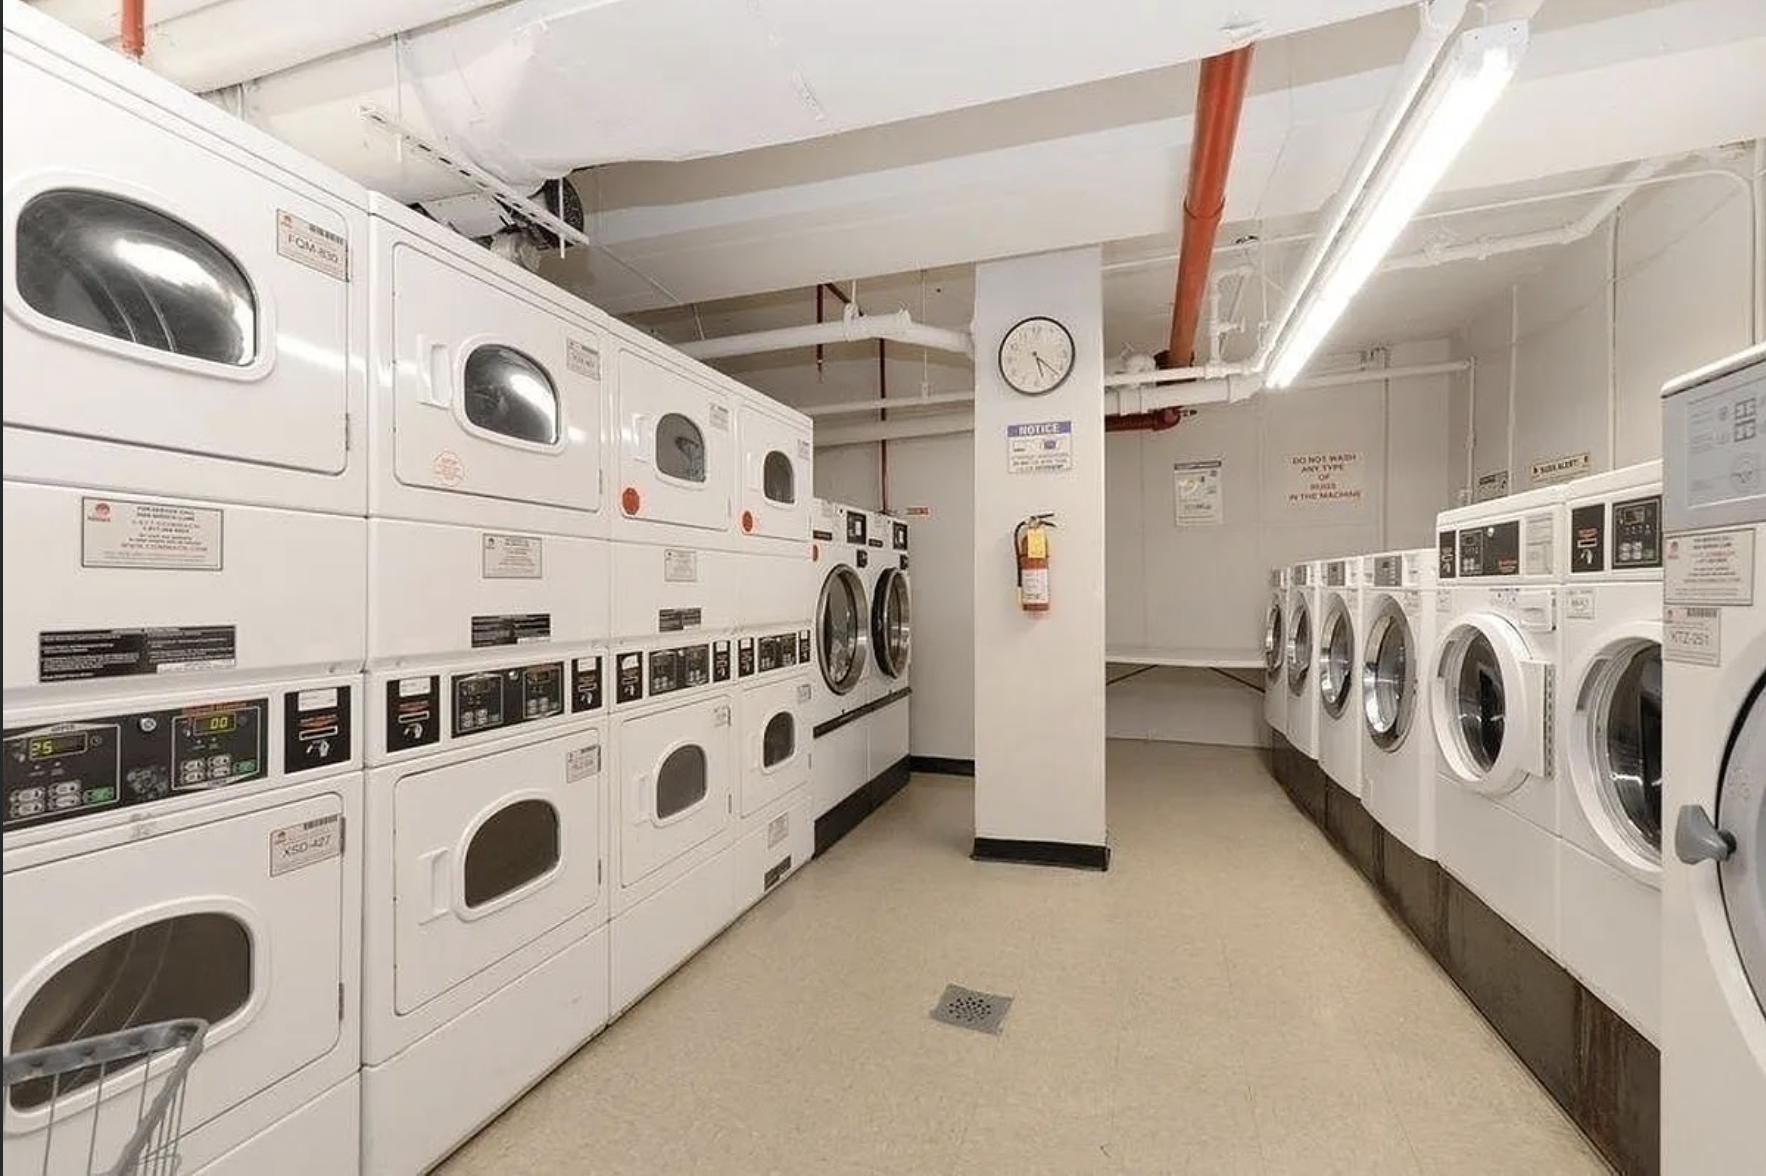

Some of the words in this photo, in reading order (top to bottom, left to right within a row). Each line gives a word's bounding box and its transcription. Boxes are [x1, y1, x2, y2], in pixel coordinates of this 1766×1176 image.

[1018, 423, 1060, 436] NOTICE
[1308, 455, 1326, 464] NOT
[1329, 453, 1357, 463] WASH
[1301, 465, 1319, 473] ANY
